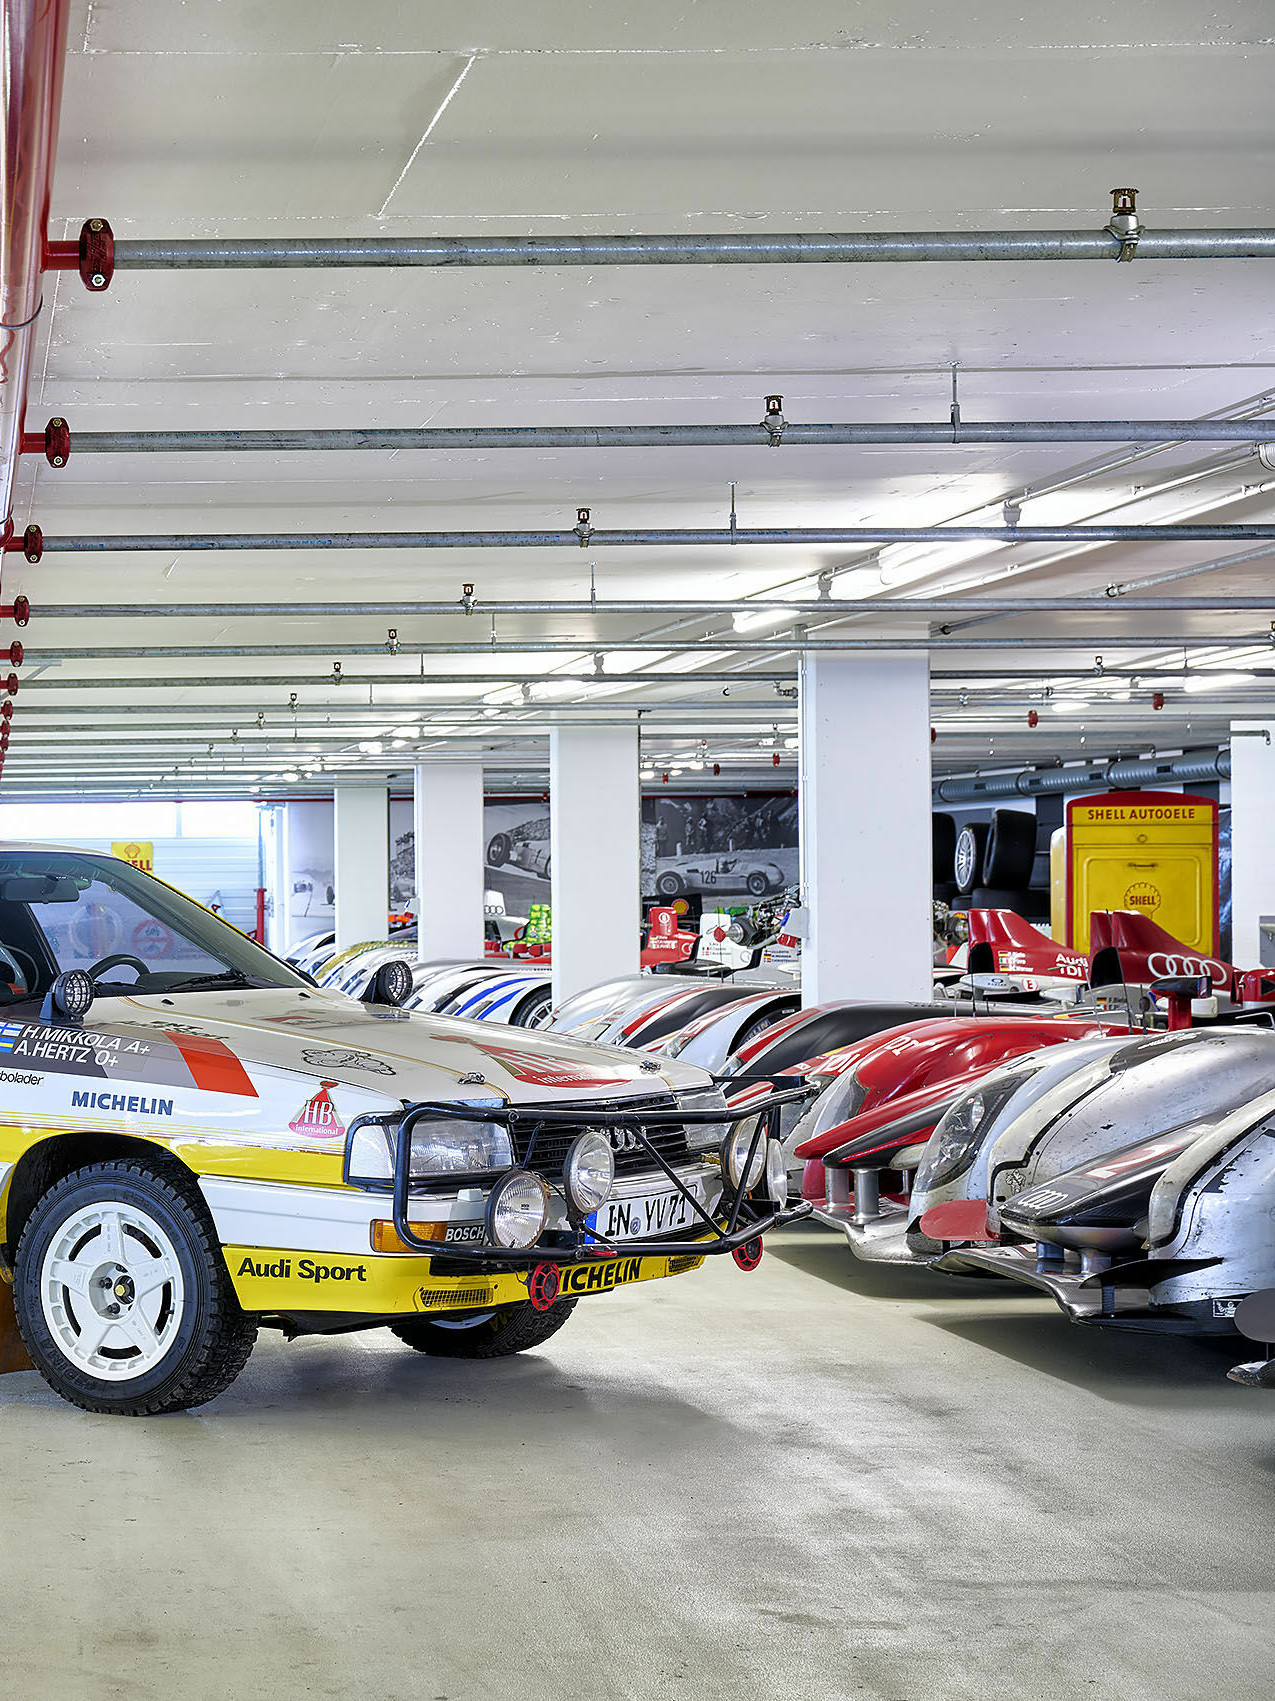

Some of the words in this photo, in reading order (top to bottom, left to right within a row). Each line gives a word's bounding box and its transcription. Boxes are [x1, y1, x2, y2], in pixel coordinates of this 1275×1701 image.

[1087, 808, 1126, 820] SHELL
[1129, 808, 1196, 820] AUTOOELE
[700, 870, 717, 885] 126
[1129, 895, 1156, 906] SHELL
[1055, 953, 1088, 967] Audi
[1055, 963, 1083, 977] TDI
[22, 1025, 122, 1051] H.MIKKOLA
[124, 1040, 151, 1055] A+
[14, 1039, 92, 1064] A.HERTZ
[71, 1090, 174, 1117] MICHELIN
[303, 1099, 335, 1127] HB
[294, 1124, 339, 1136] international
[445, 1225, 486, 1242] BOSCH
[237, 1257, 291, 1278] Audi
[297, 1259, 367, 1283] Sport
[559, 1256, 643, 1293] ICHELIN
